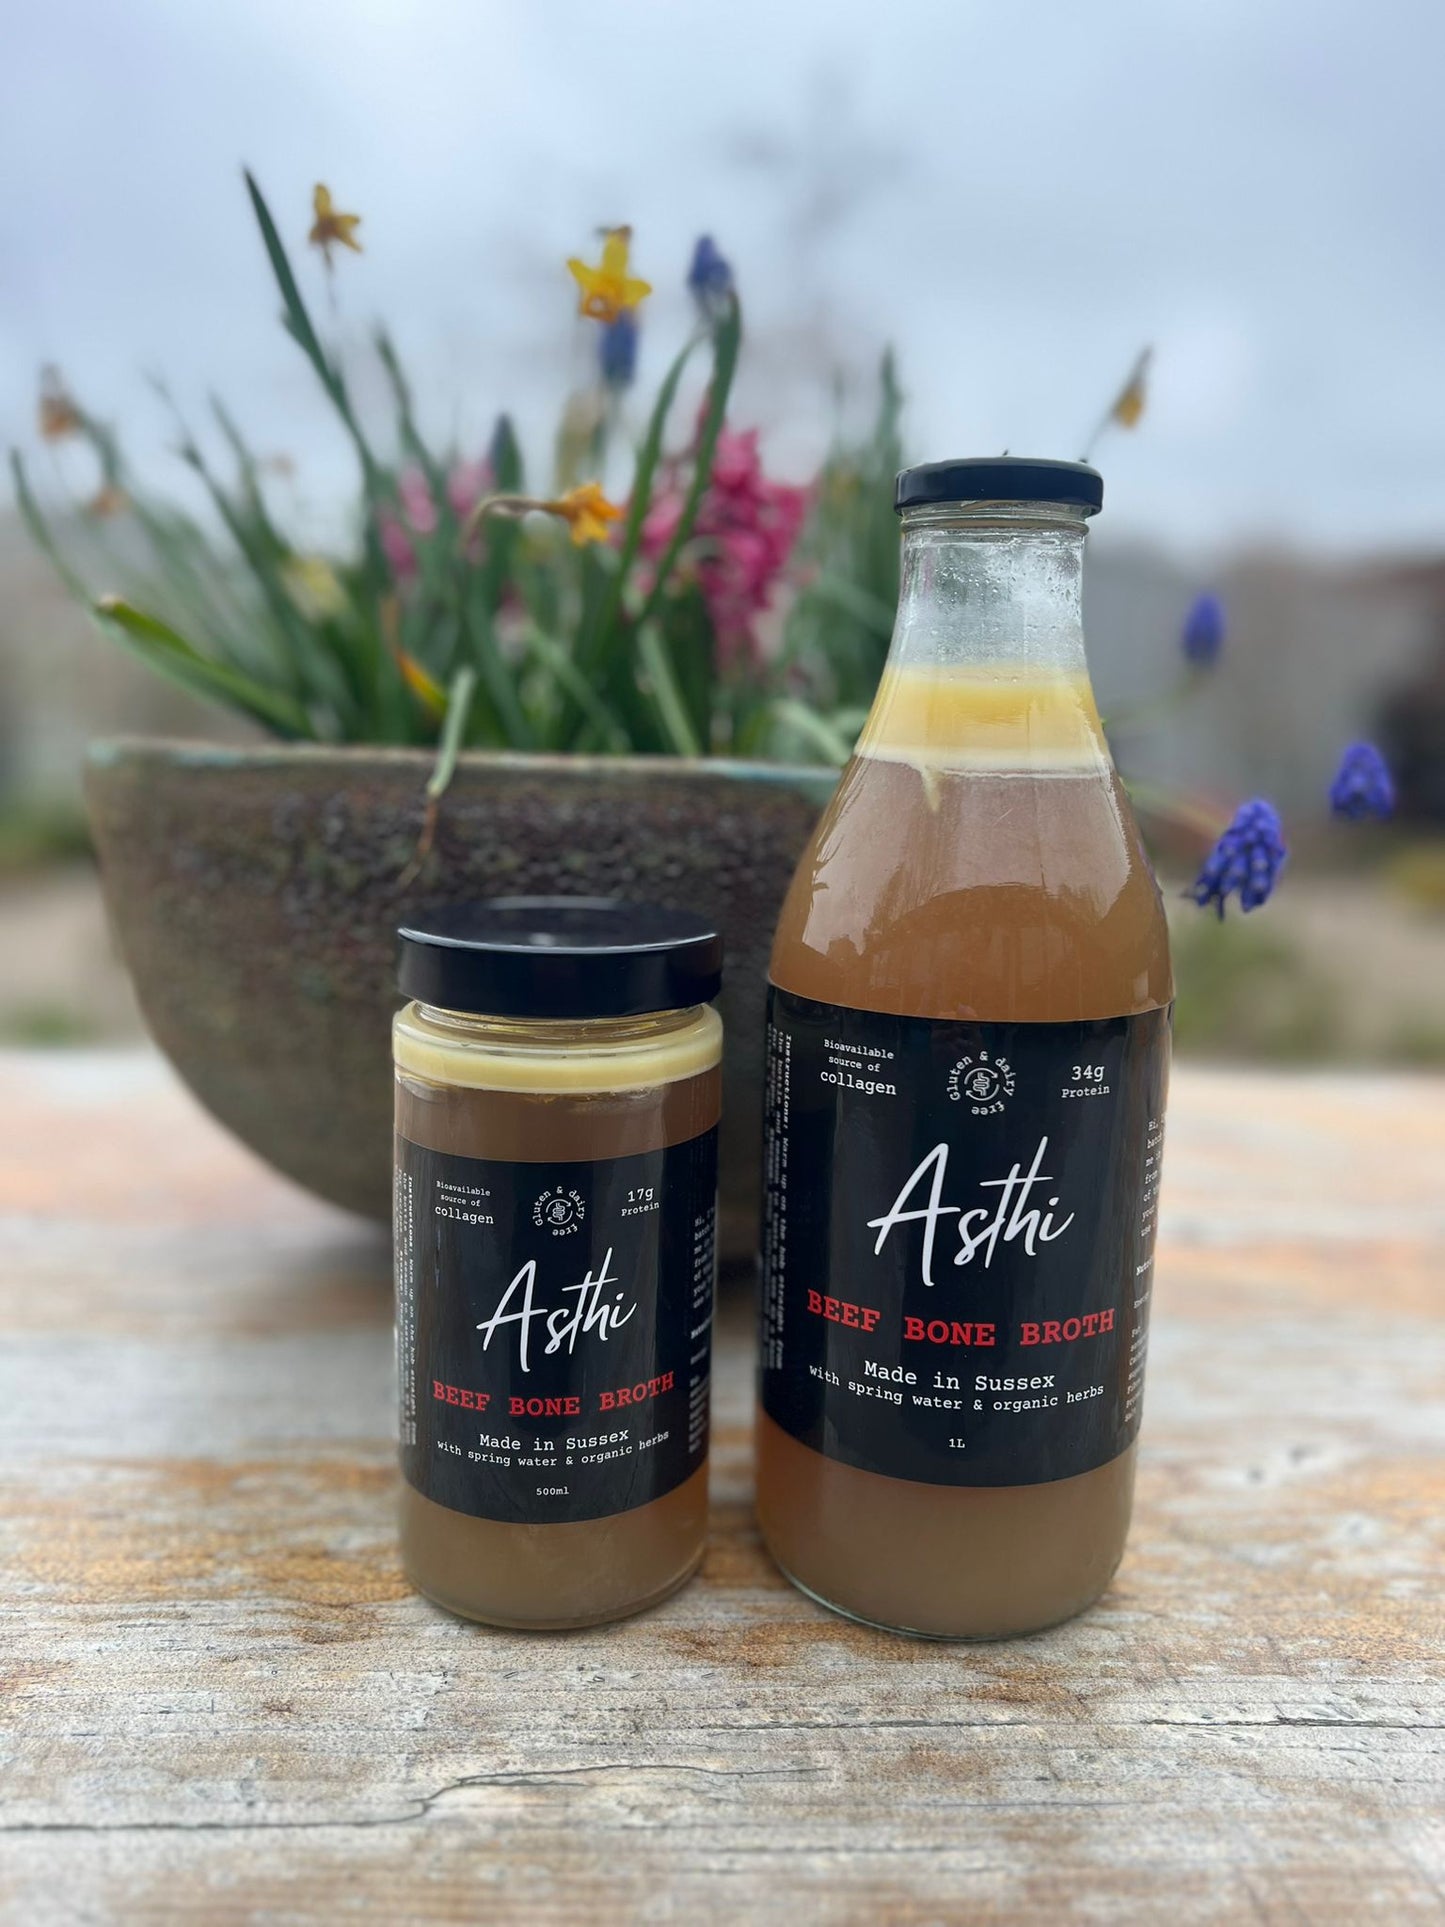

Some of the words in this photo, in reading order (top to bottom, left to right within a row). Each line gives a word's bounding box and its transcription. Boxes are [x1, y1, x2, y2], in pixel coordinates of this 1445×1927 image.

[824, 1039, 895, 1060] Bioavailable
[980, 1050, 989, 1061] &
[828, 1055, 862, 1069] source
[867, 1063, 881, 1073] of
[1071, 1064, 1105, 1082] 34g
[820, 1071, 897, 1096] collagen
[946, 1055, 973, 1101] Gluten
[994, 1057, 1017, 1097] dairy
[1061, 1084, 1110, 1098] Protein
[971, 1100, 1005, 1116] free
[436, 1180, 491, 1197] Bioavailable
[556, 1186, 564, 1194] &
[627, 1187, 655, 1202] 17g
[440, 1193, 467, 1206] source
[470, 1199, 481, 1207] of
[533, 1190, 551, 1227] Gluten
[568, 1189, 585, 1220] dairy
[621, 1201, 660, 1217] Protein
[434, 1205, 495, 1225] collagen
[866, 1135, 1075, 1287] Asthi
[552, 1222, 578, 1236] free
[476, 1246, 637, 1373] Asthi
[807, 1288, 881, 1333] BEEF
[904, 1316, 996, 1346] BONE
[1020, 1308, 1115, 1346] BROTH
[864, 1360, 917, 1385] Made
[933, 1371, 960, 1390] in
[975, 1373, 1056, 1391] Sussex
[432, 1380, 491, 1412] BEEF
[508, 1396, 580, 1417] BONE
[599, 1371, 675, 1412] BROTH
[809, 1364, 840, 1386] with
[848, 1379, 903, 1405] spring
[912, 1395, 963, 1410] water
[973, 1399, 983, 1411] &
[993, 1395, 1058, 1413] organic
[1066, 1384, 1104, 1404] herbs
[437, 1440, 462, 1456] with
[468, 1449, 511, 1467] spring
[518, 1456, 557, 1466] water
[566, 1456, 573, 1465] &
[581, 1445, 633, 1464] organic
[638, 1430, 669, 1450] herbs
[479, 1433, 521, 1450] Made
[534, 1437, 554, 1451] in
[566, 1429, 629, 1450] Sussex
[948, 1438, 966, 1449] 1L
[536, 1486, 570, 1496] 500ml
